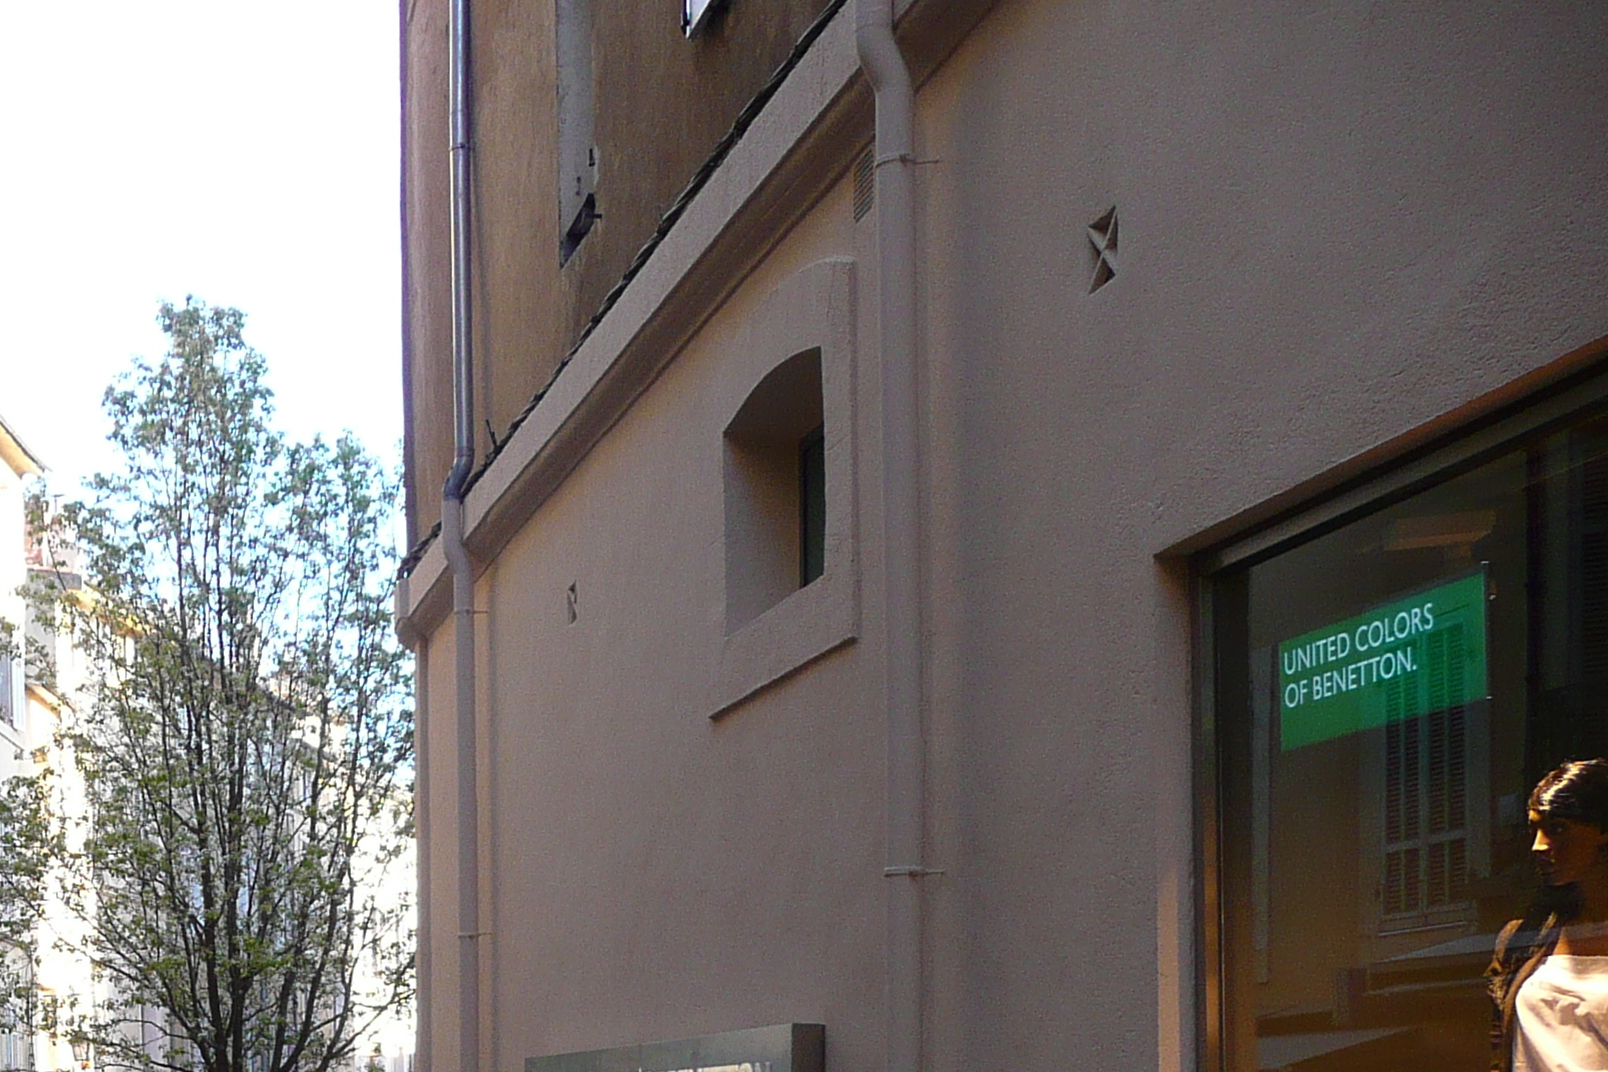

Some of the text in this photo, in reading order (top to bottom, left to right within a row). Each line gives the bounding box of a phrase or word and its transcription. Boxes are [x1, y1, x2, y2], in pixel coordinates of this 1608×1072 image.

[1284, 603, 1434, 675] UNITED COLORS
[1285, 647, 1417, 707] OF BENETTON.
